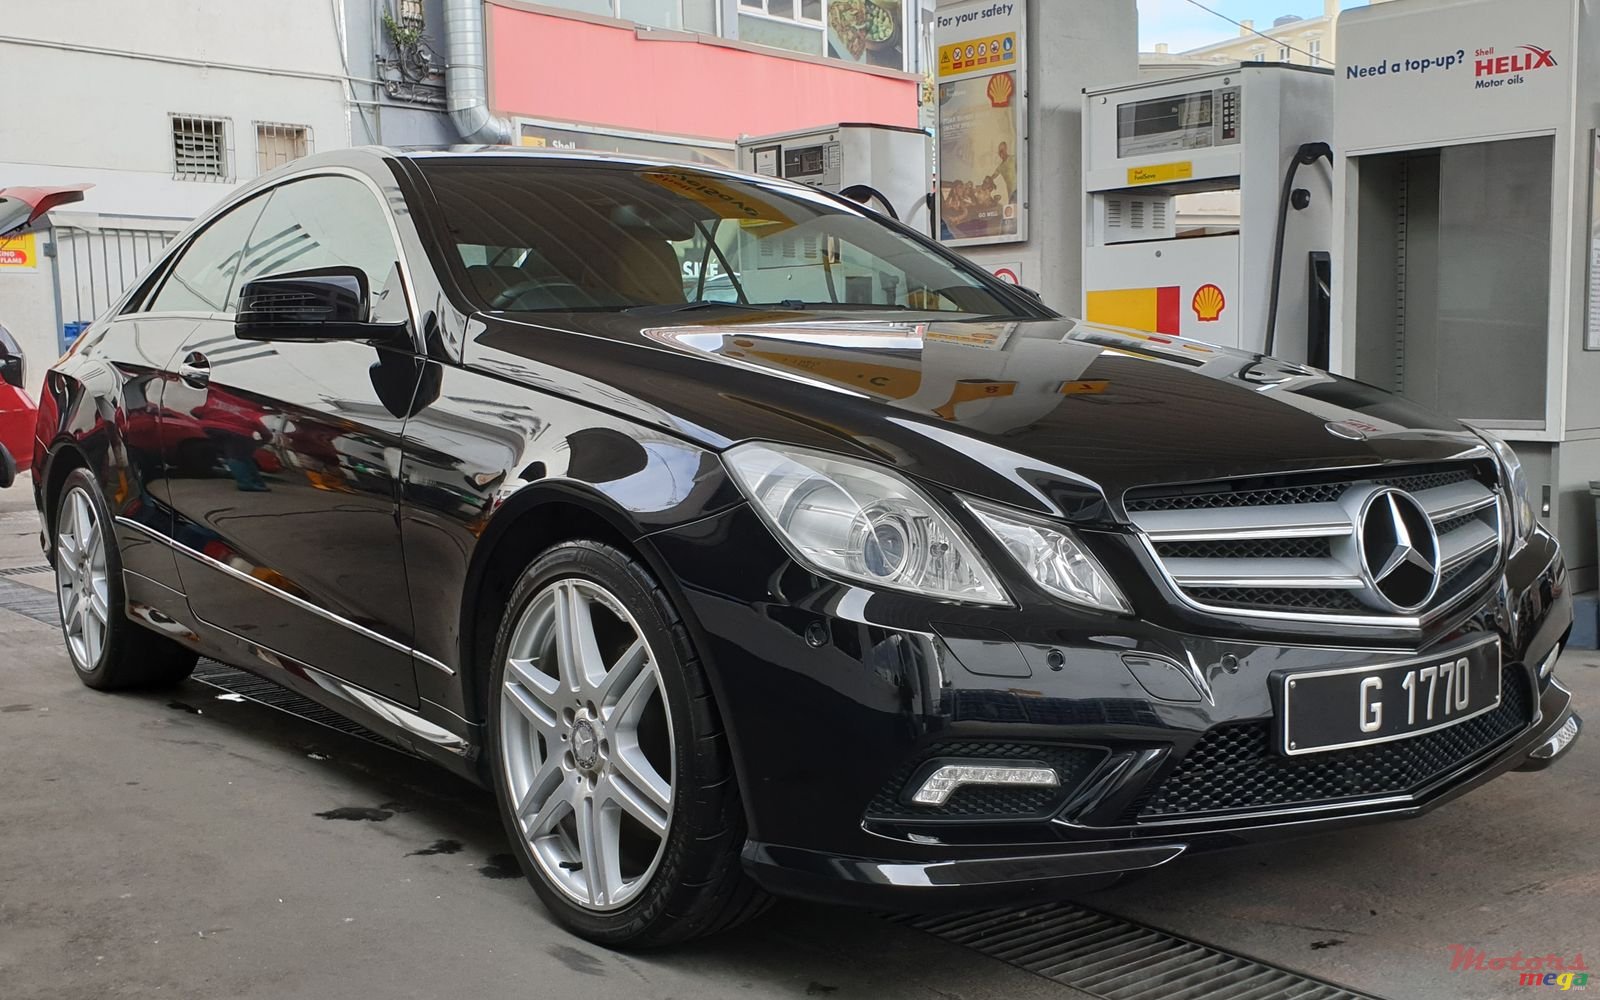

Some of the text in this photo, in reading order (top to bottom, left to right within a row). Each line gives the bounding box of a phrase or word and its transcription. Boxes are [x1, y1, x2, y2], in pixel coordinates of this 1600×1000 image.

[937, 4, 1014, 28] For your safety
[1475, 47, 1494, 57] Shell
[1475, 49, 1555, 77] HELIX
[1346, 49, 1465, 80] Need a top-up?
[1475, 74, 1524, 90] Motor oils
[552, 139, 576, 150] Shell
[1360, 657, 1470, 733] G 1770
